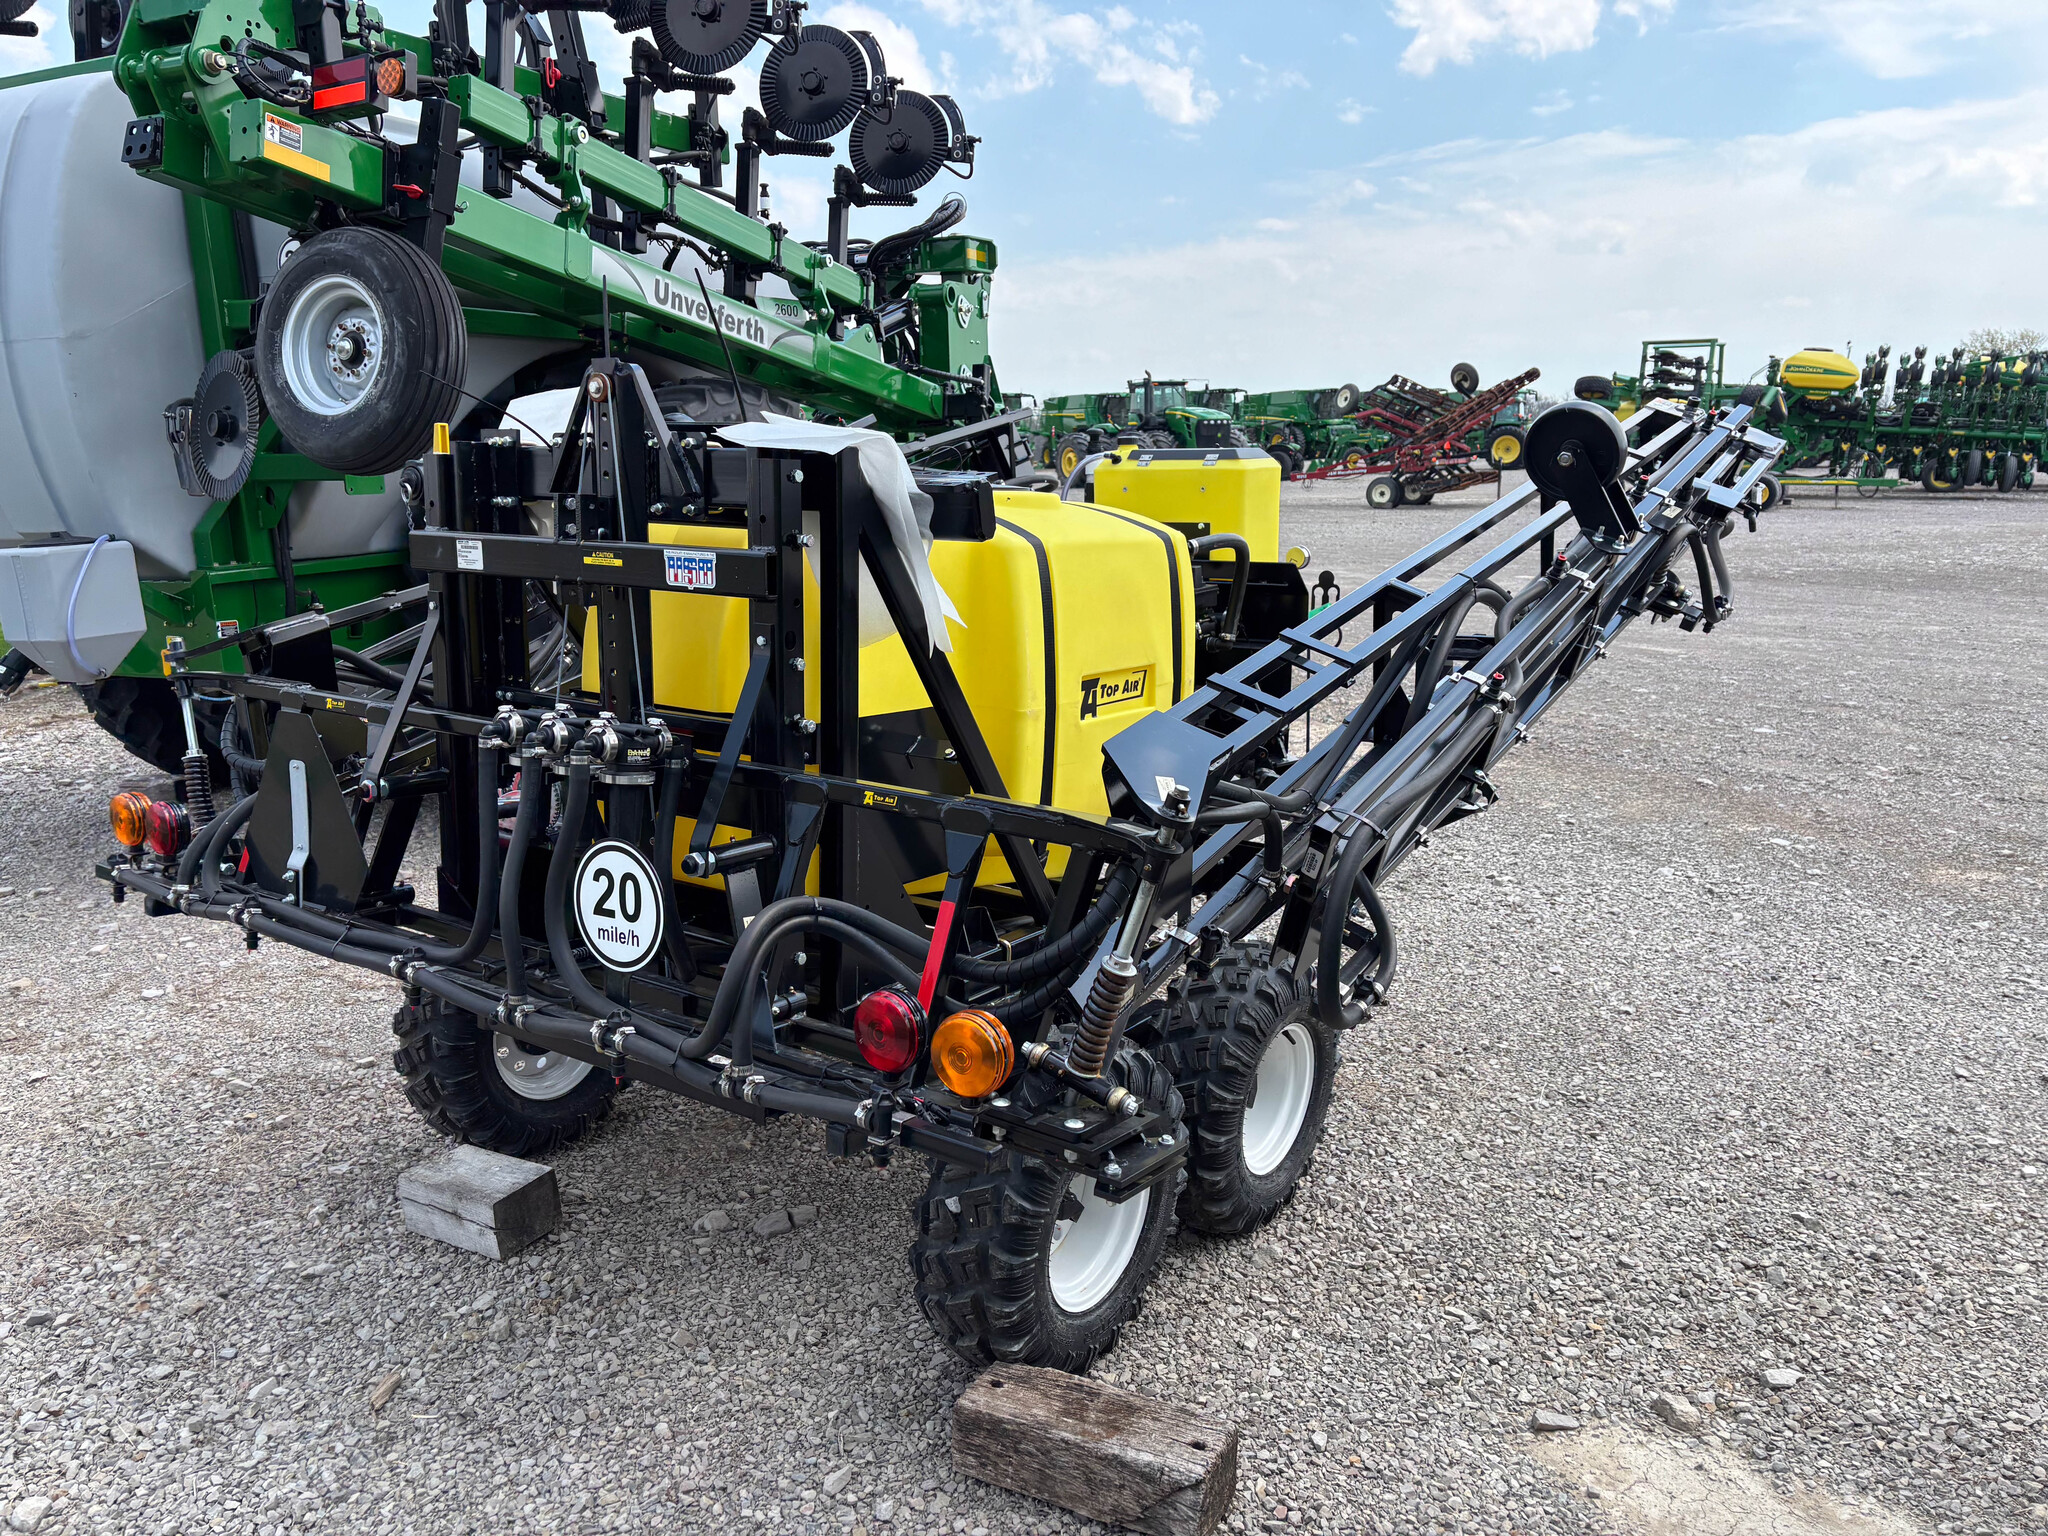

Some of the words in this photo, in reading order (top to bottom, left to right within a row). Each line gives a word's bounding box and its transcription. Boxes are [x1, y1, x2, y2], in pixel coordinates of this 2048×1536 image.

[654, 277, 766, 345] Unverferth
[774, 303, 799, 317] 2600
[667, 556, 714, 585] USA
[593, 867, 642, 923] 20
[598, 926, 640, 948] mile/h
